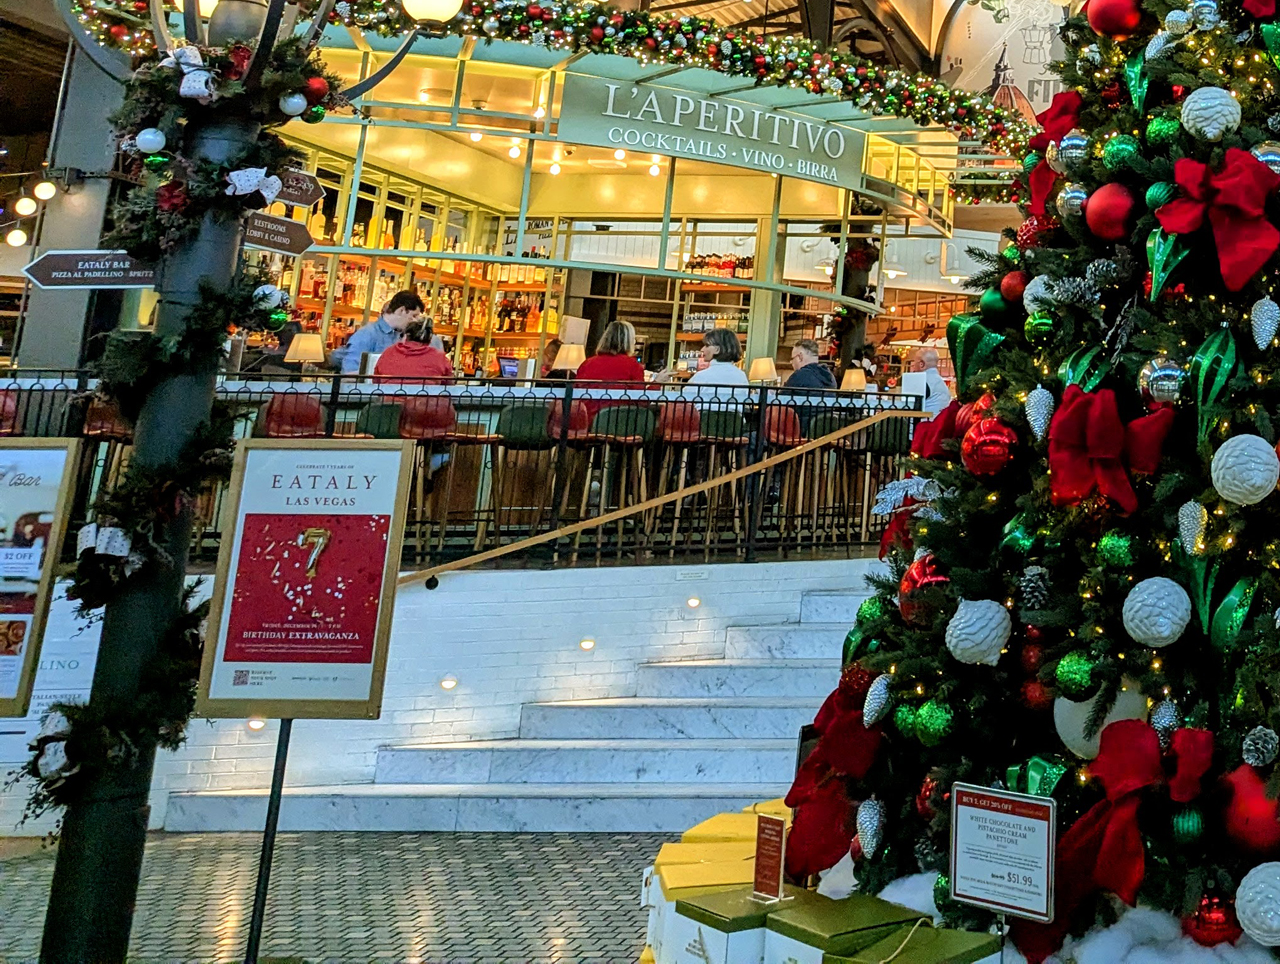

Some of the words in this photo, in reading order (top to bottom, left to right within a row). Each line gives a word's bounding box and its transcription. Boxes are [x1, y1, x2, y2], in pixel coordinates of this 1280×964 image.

[601, 83, 846, 160] L'APERITIVO
[608, 126, 727, 160] COCKTAILS
[742, 147, 785, 170] VINO
[796, 159, 839, 182] BIRRA
[253, 218, 287, 234] RESTROOMS
[246, 229, 264, 239] LOBBY
[269, 233, 291, 246] CASINO
[77, 260, 111, 270] EATALY
[112, 260, 131, 269] BAR
[51, 271, 72, 279] PIZZA
[83, 270, 125, 279] PADELLINO
[8, 471, 43, 488] Bar
[271, 474, 378, 490] EATALY
[285, 497, 309, 506] LAS
[314, 497, 356, 506] VEGAS
[4, 552, 14, 560] $2
[15, 552, 35, 561] OFF
[242, 631, 286, 640] BIRTHDAY
[288, 632, 360, 641] EXTRAVAGANZA
[40, 660, 79, 670] LINO
[970, 814, 988, 824] WHITE
[988, 817, 1022, 831] CHOCOLATE
[1024, 825, 1036, 833] AND
[986, 833, 1019, 846] PANETTONE
[1007, 871, 1033, 887] $51.99
